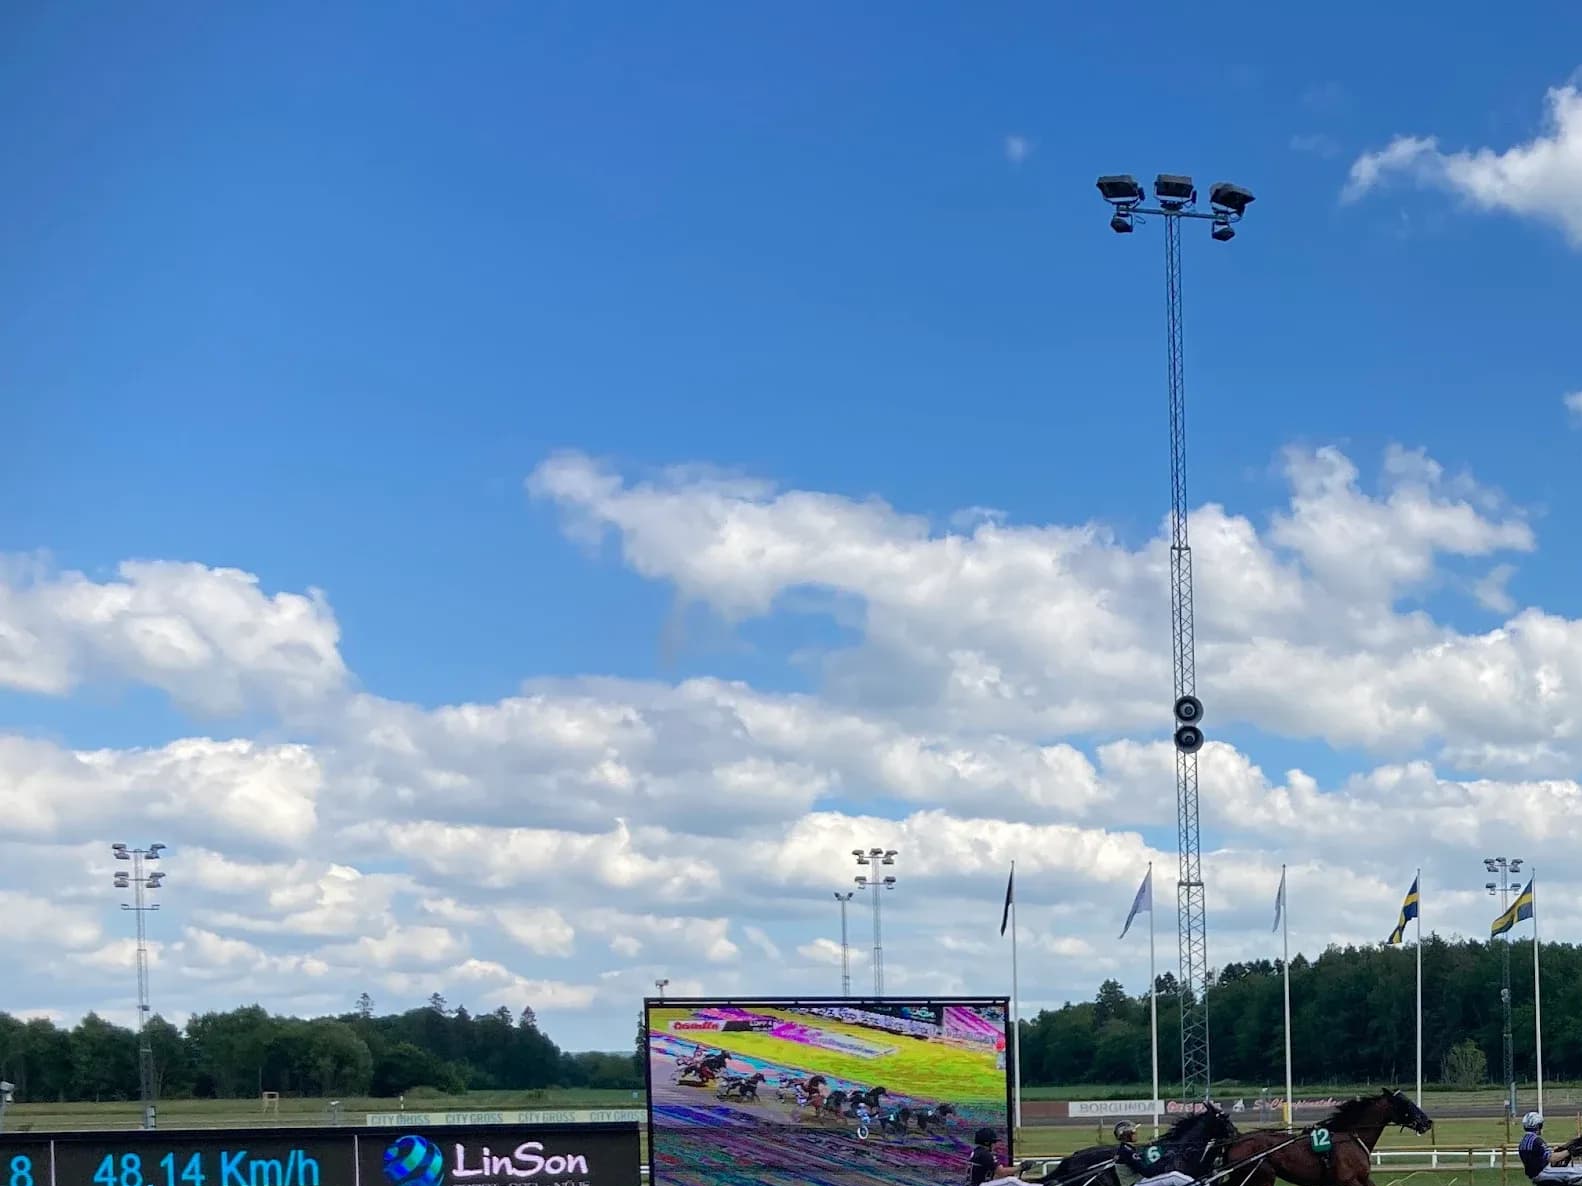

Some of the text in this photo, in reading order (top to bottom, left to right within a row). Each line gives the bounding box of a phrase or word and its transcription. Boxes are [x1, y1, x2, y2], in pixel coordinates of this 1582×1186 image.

[371, 1114, 394, 1125] CITY
[445, 1113, 468, 1124] CITY
[518, 1112, 540, 1123] CITY
[590, 1111, 612, 1122] CITY
[1310, 1127, 1331, 1147] 12
[1147, 1145, 1161, 1163] 6
[451, 1141, 589, 1179] LinSon
